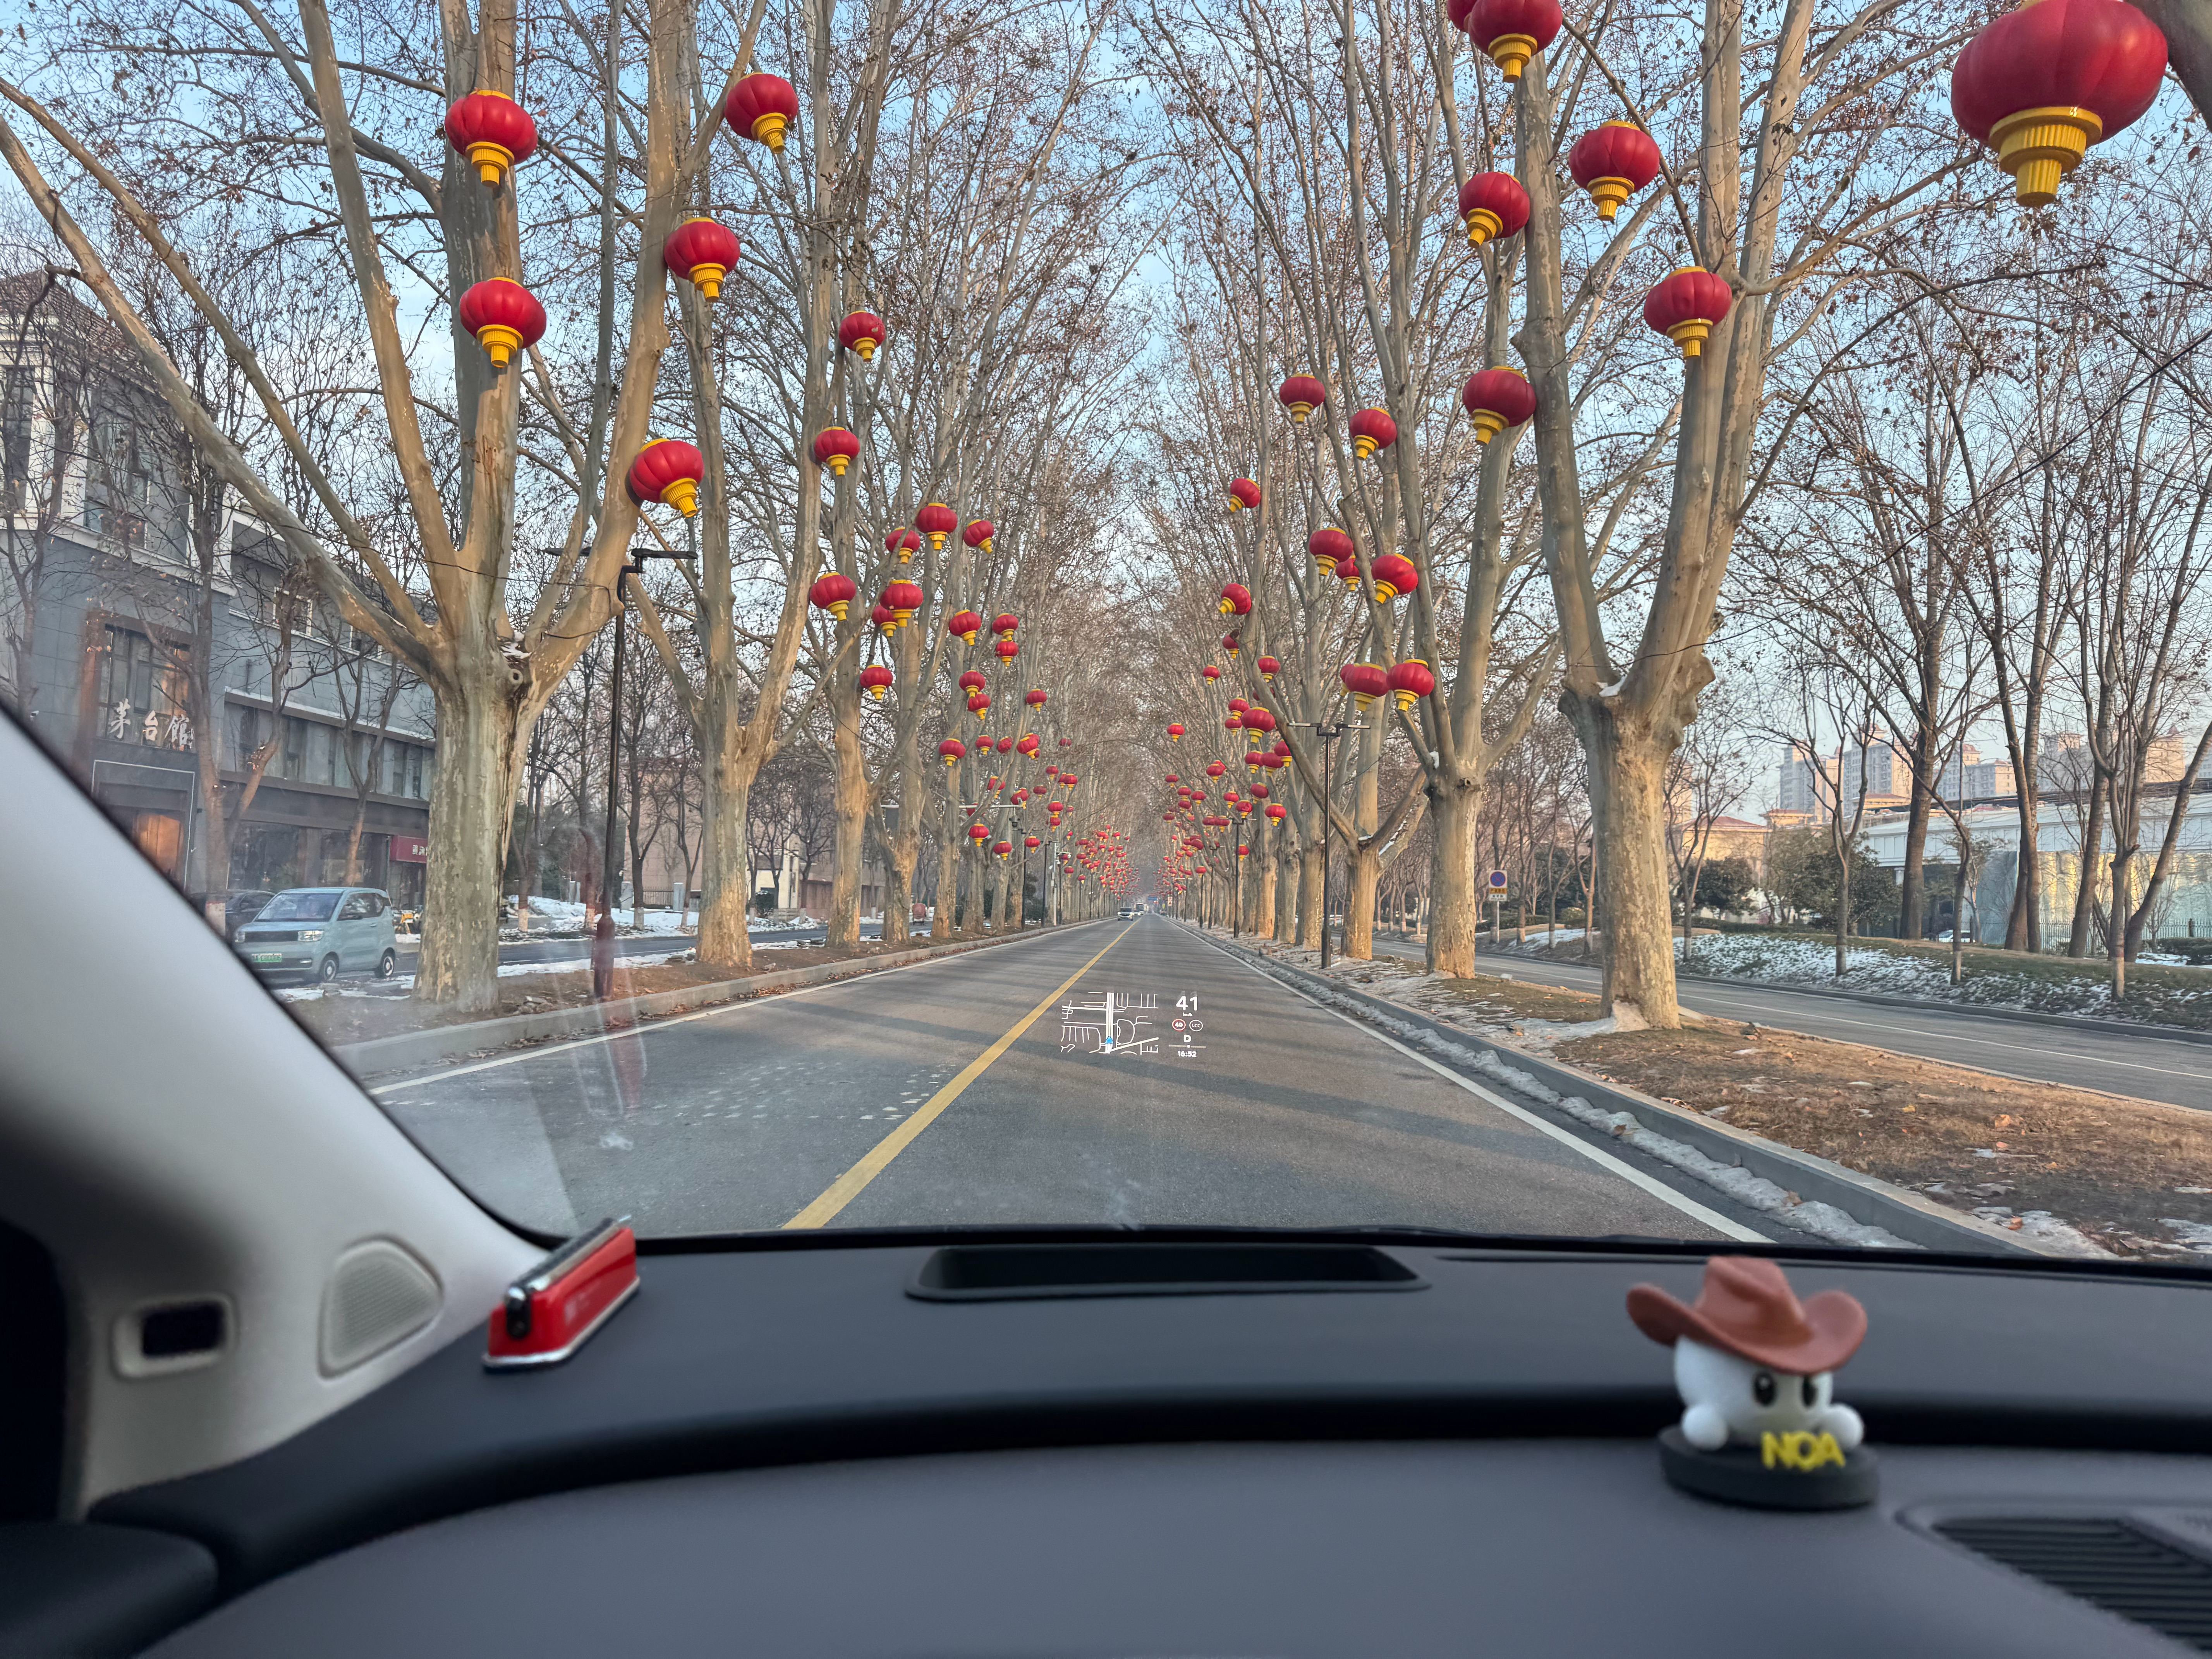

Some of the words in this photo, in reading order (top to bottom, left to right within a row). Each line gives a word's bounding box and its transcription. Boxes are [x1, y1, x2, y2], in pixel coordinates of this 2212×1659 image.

[1176, 996, 1197, 1011] 41
[1183, 1034, 1192, 1042] D
[1761, 1431, 1846, 1470] NOA
